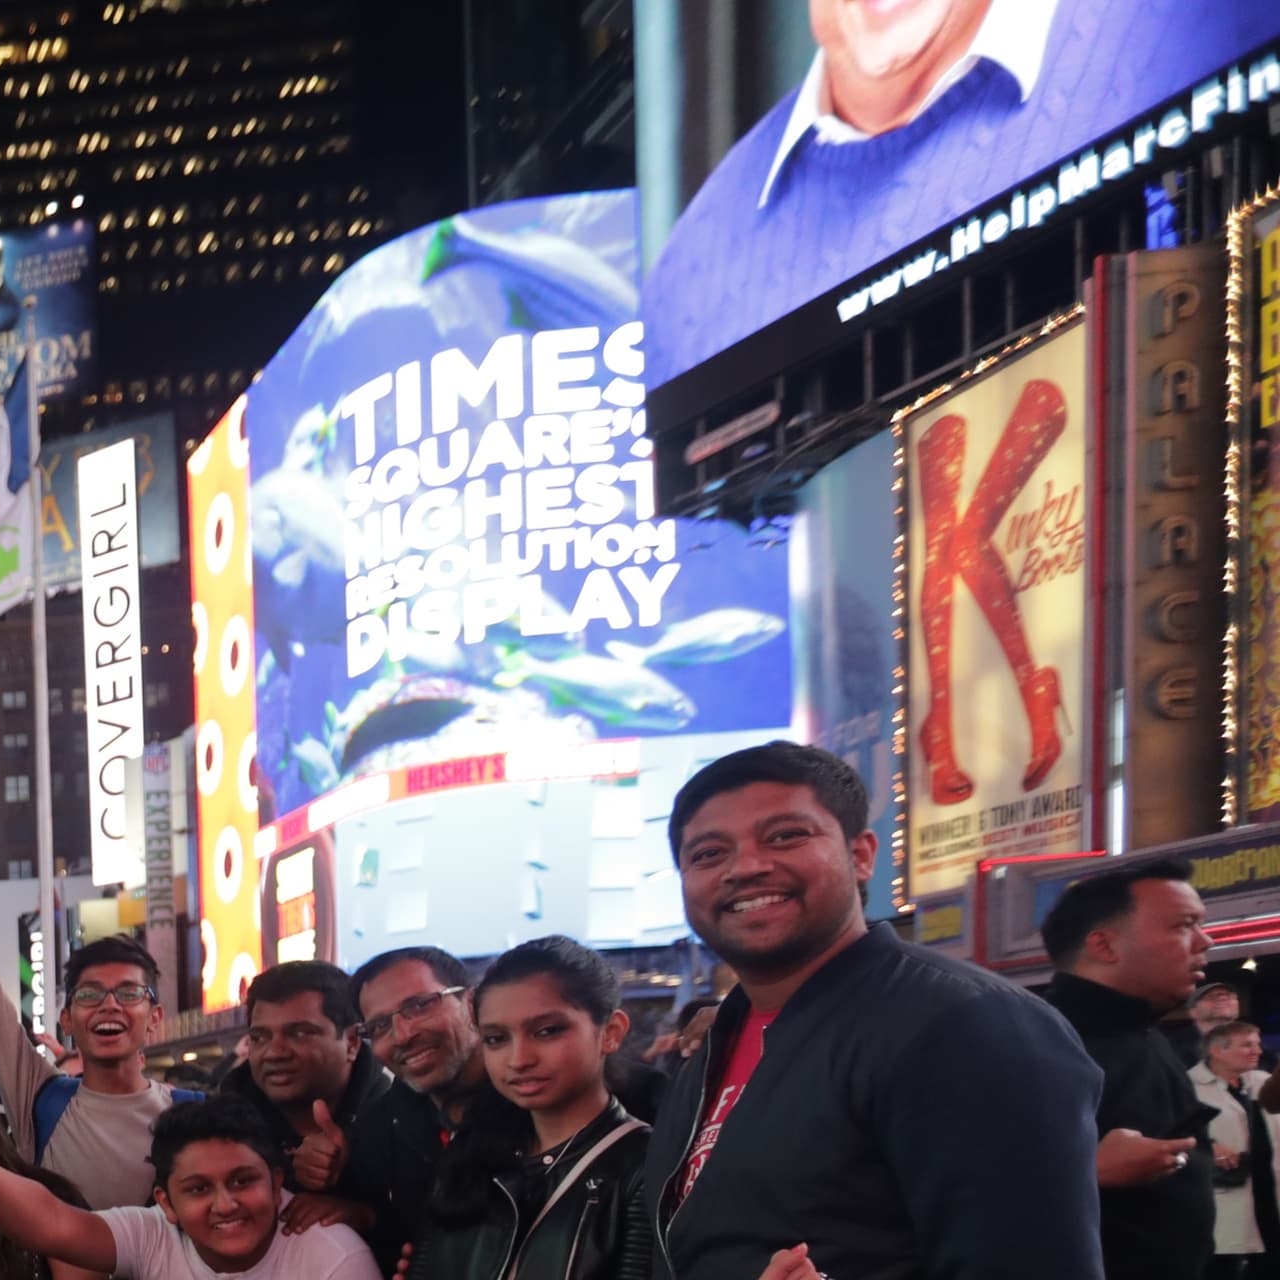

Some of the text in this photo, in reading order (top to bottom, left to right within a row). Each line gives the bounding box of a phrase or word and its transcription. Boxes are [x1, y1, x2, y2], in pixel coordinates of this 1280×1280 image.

[342, 321, 646, 465] TIMES
[343, 461, 655, 580] HIGHEST
[345, 520, 677, 620] RESOLUTION
[91, 482, 132, 841] COVERGIRL
[346, 563, 680, 679] DISPLAY
[406, 752, 506, 795] HERSHEY'S
[146, 789, 175, 930] EXPERIENCE
